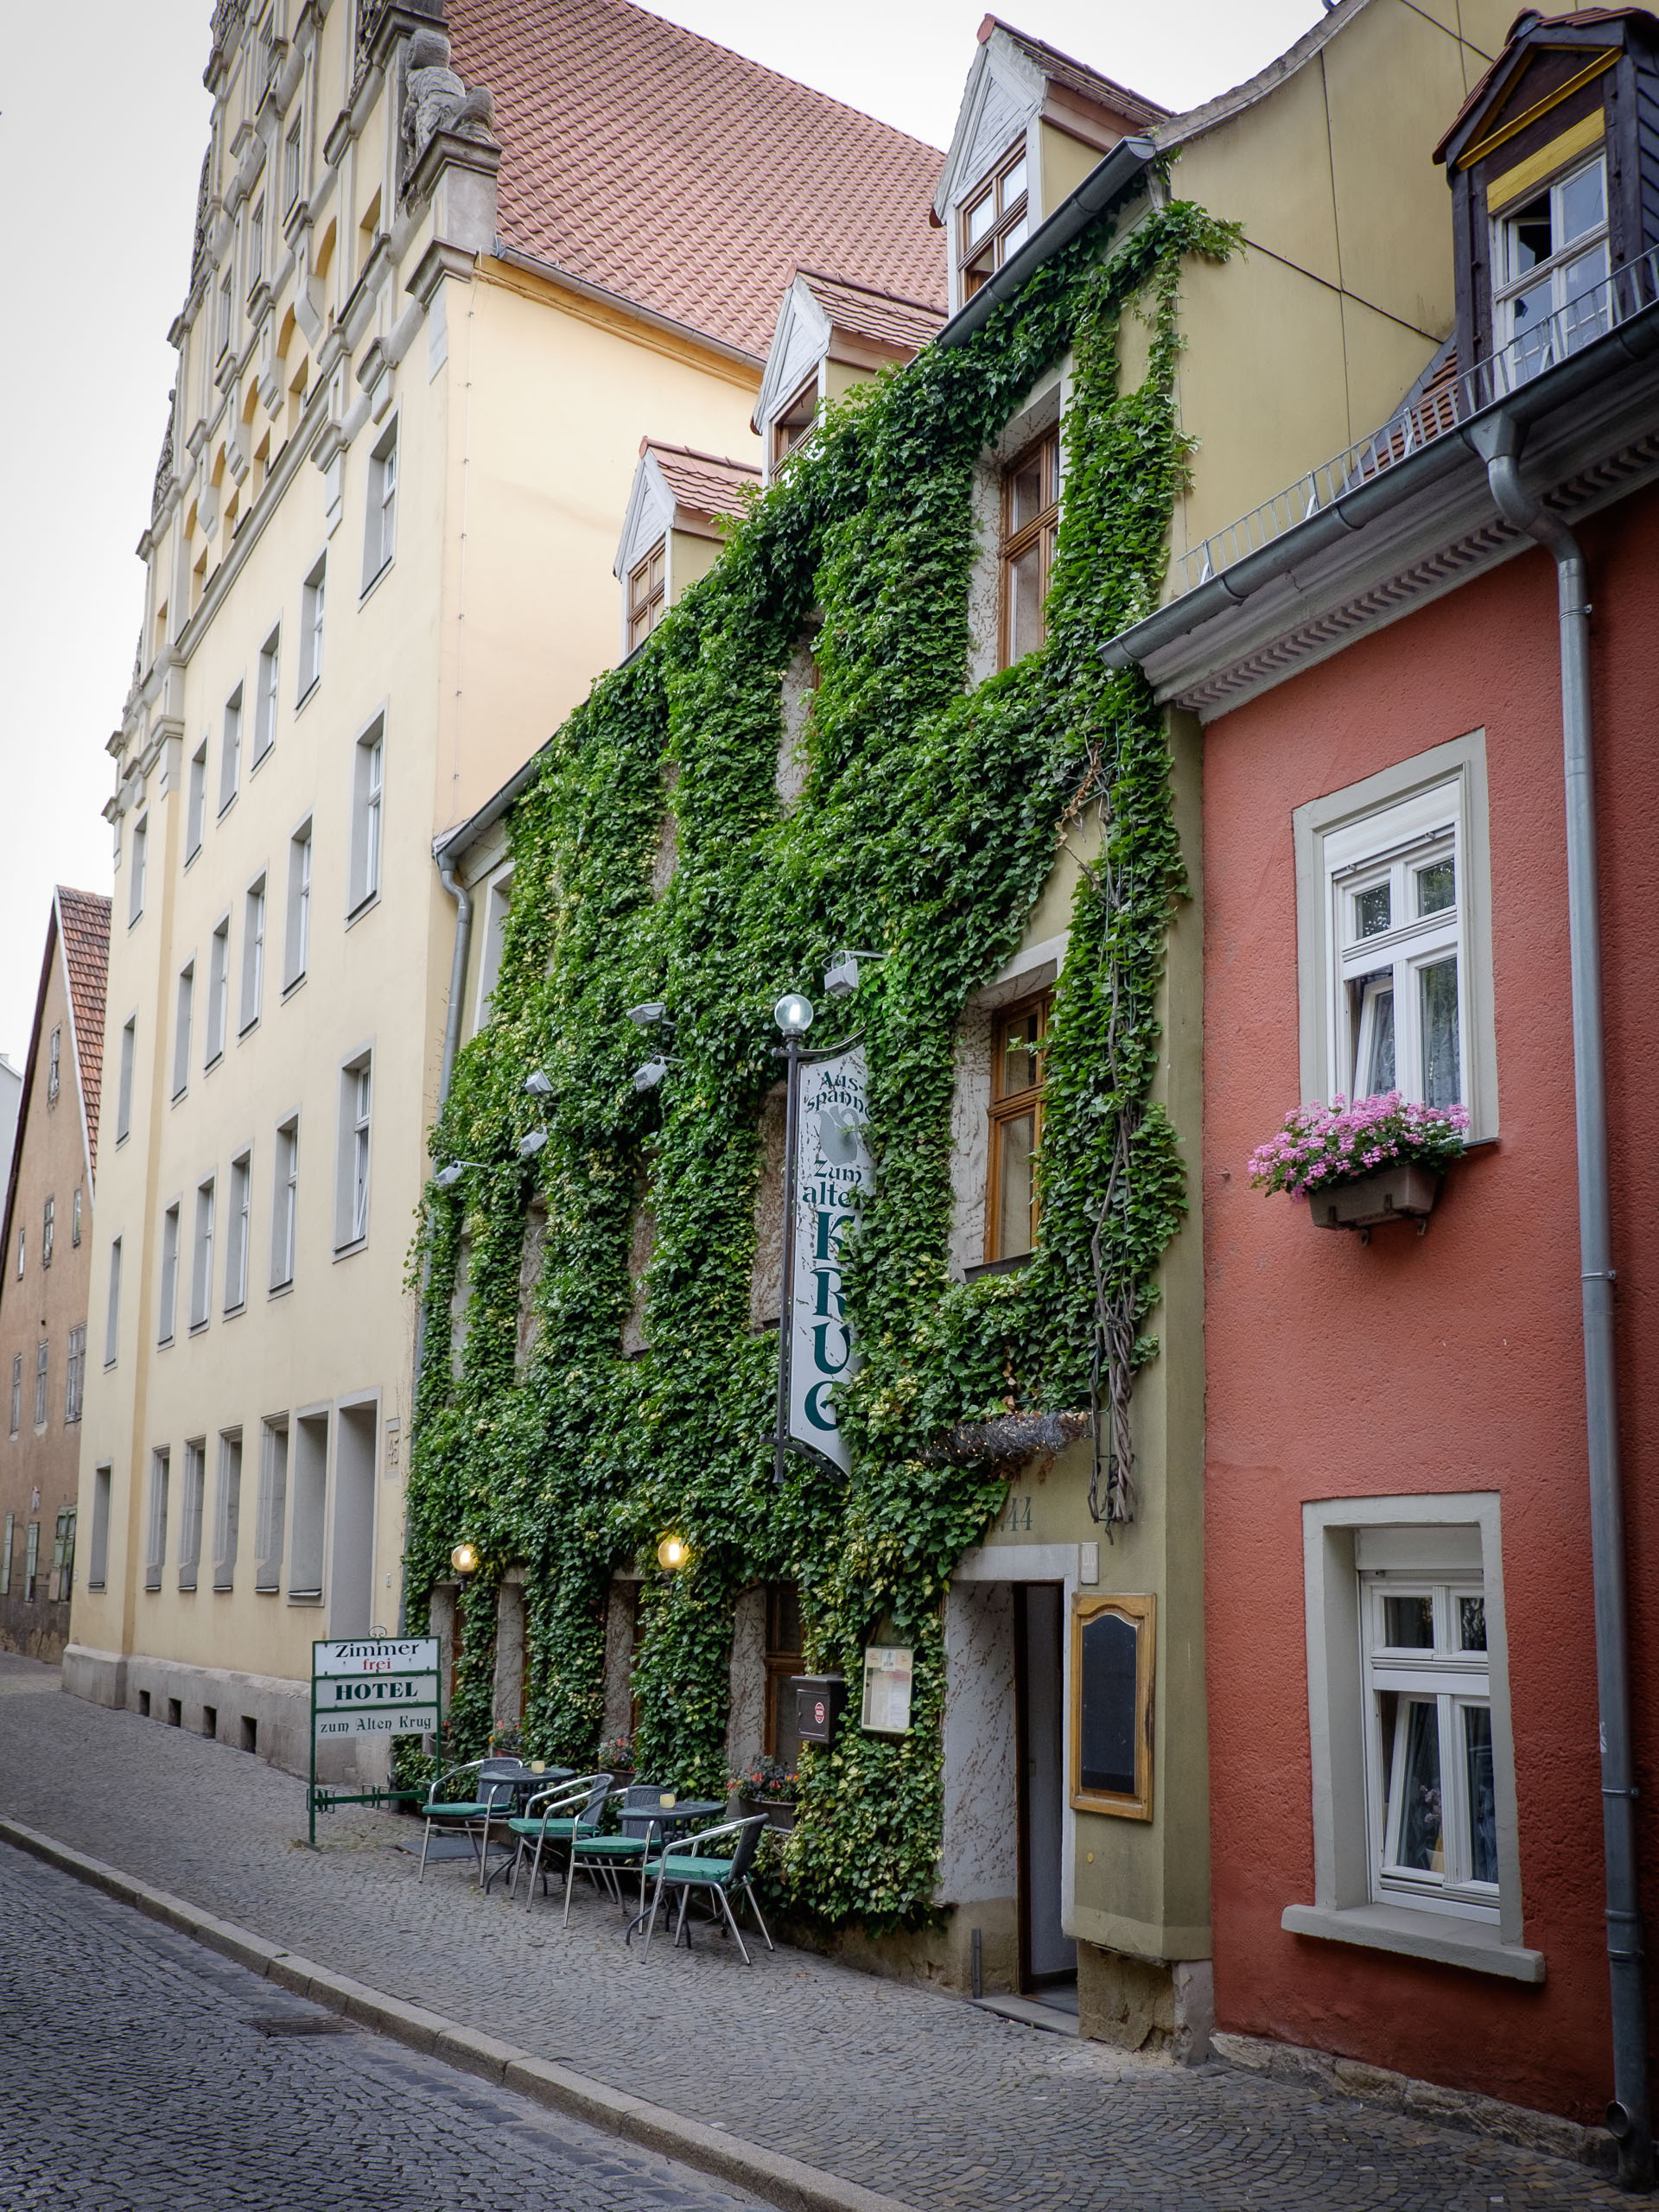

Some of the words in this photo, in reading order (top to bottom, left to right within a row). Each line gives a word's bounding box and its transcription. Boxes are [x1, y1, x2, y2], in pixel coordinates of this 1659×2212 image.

[820, 1071, 864, 1092] Aus-
[802, 1181, 861, 1210] alte
[1006, 1497, 1033, 1532] 44
[334, 1643, 420, 1658] Zimmer
[363, 1658, 391, 1670] frei
[335, 1681, 418, 1700] HOTEL
[356, 1718, 392, 1732] Alten
[399, 1715, 431, 1729] Krug
